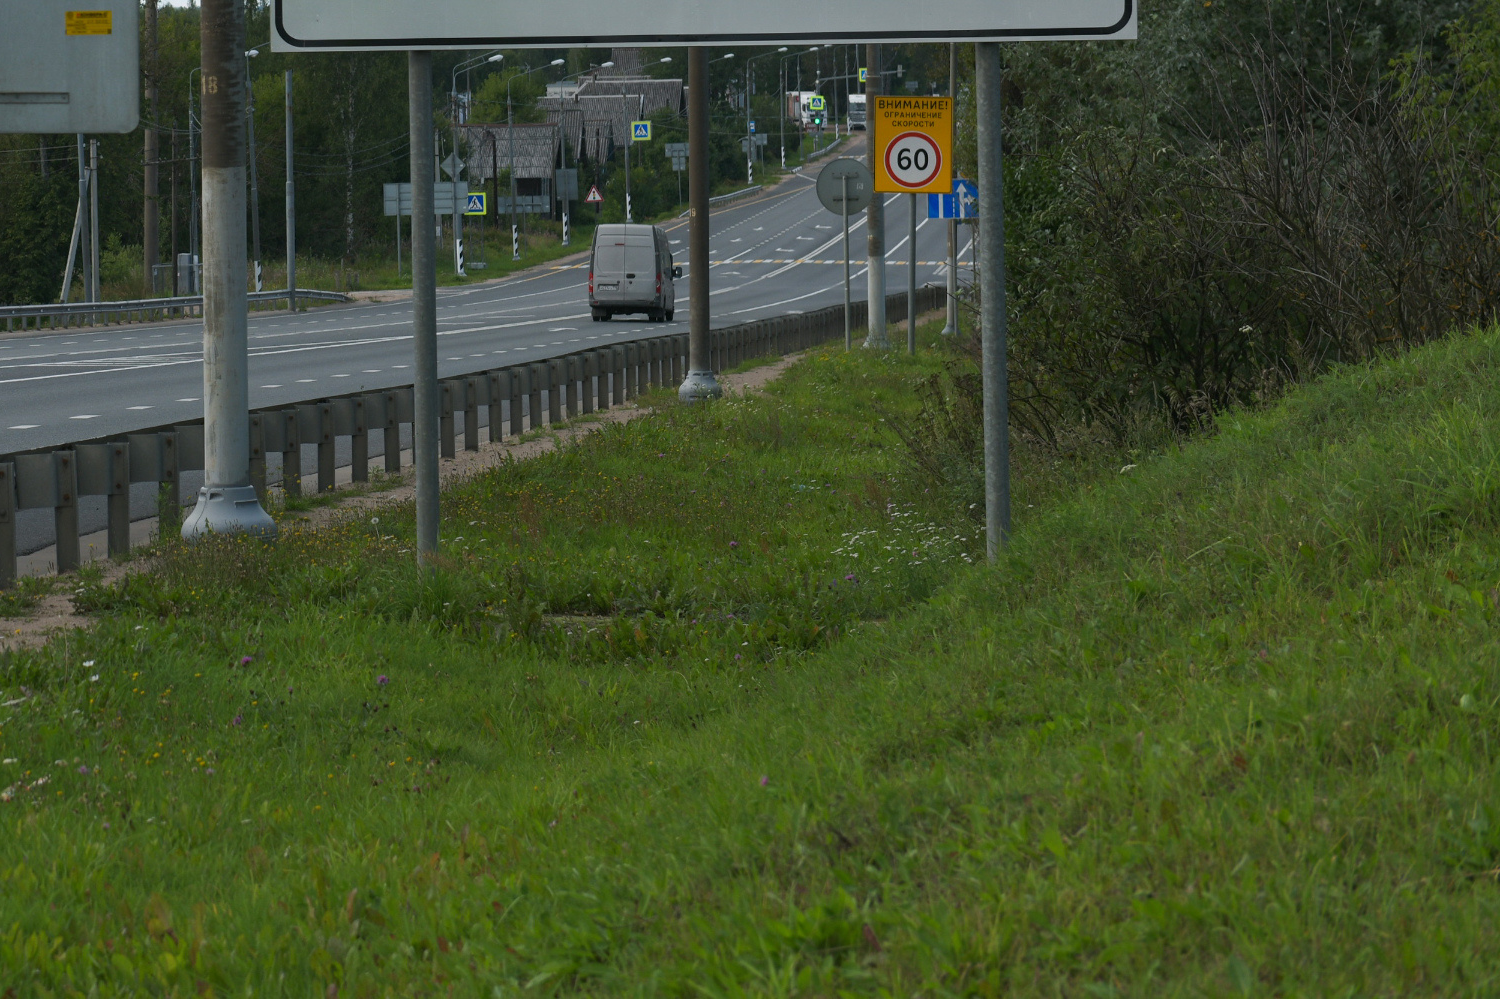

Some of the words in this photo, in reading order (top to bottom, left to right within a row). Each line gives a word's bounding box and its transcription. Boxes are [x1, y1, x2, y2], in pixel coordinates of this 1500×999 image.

[878, 100, 948, 110] ВНИМАНИЕ!
[884, 111, 942, 119] ОГРАНИЧЕНИЕ
[897, 148, 929, 171] 60
